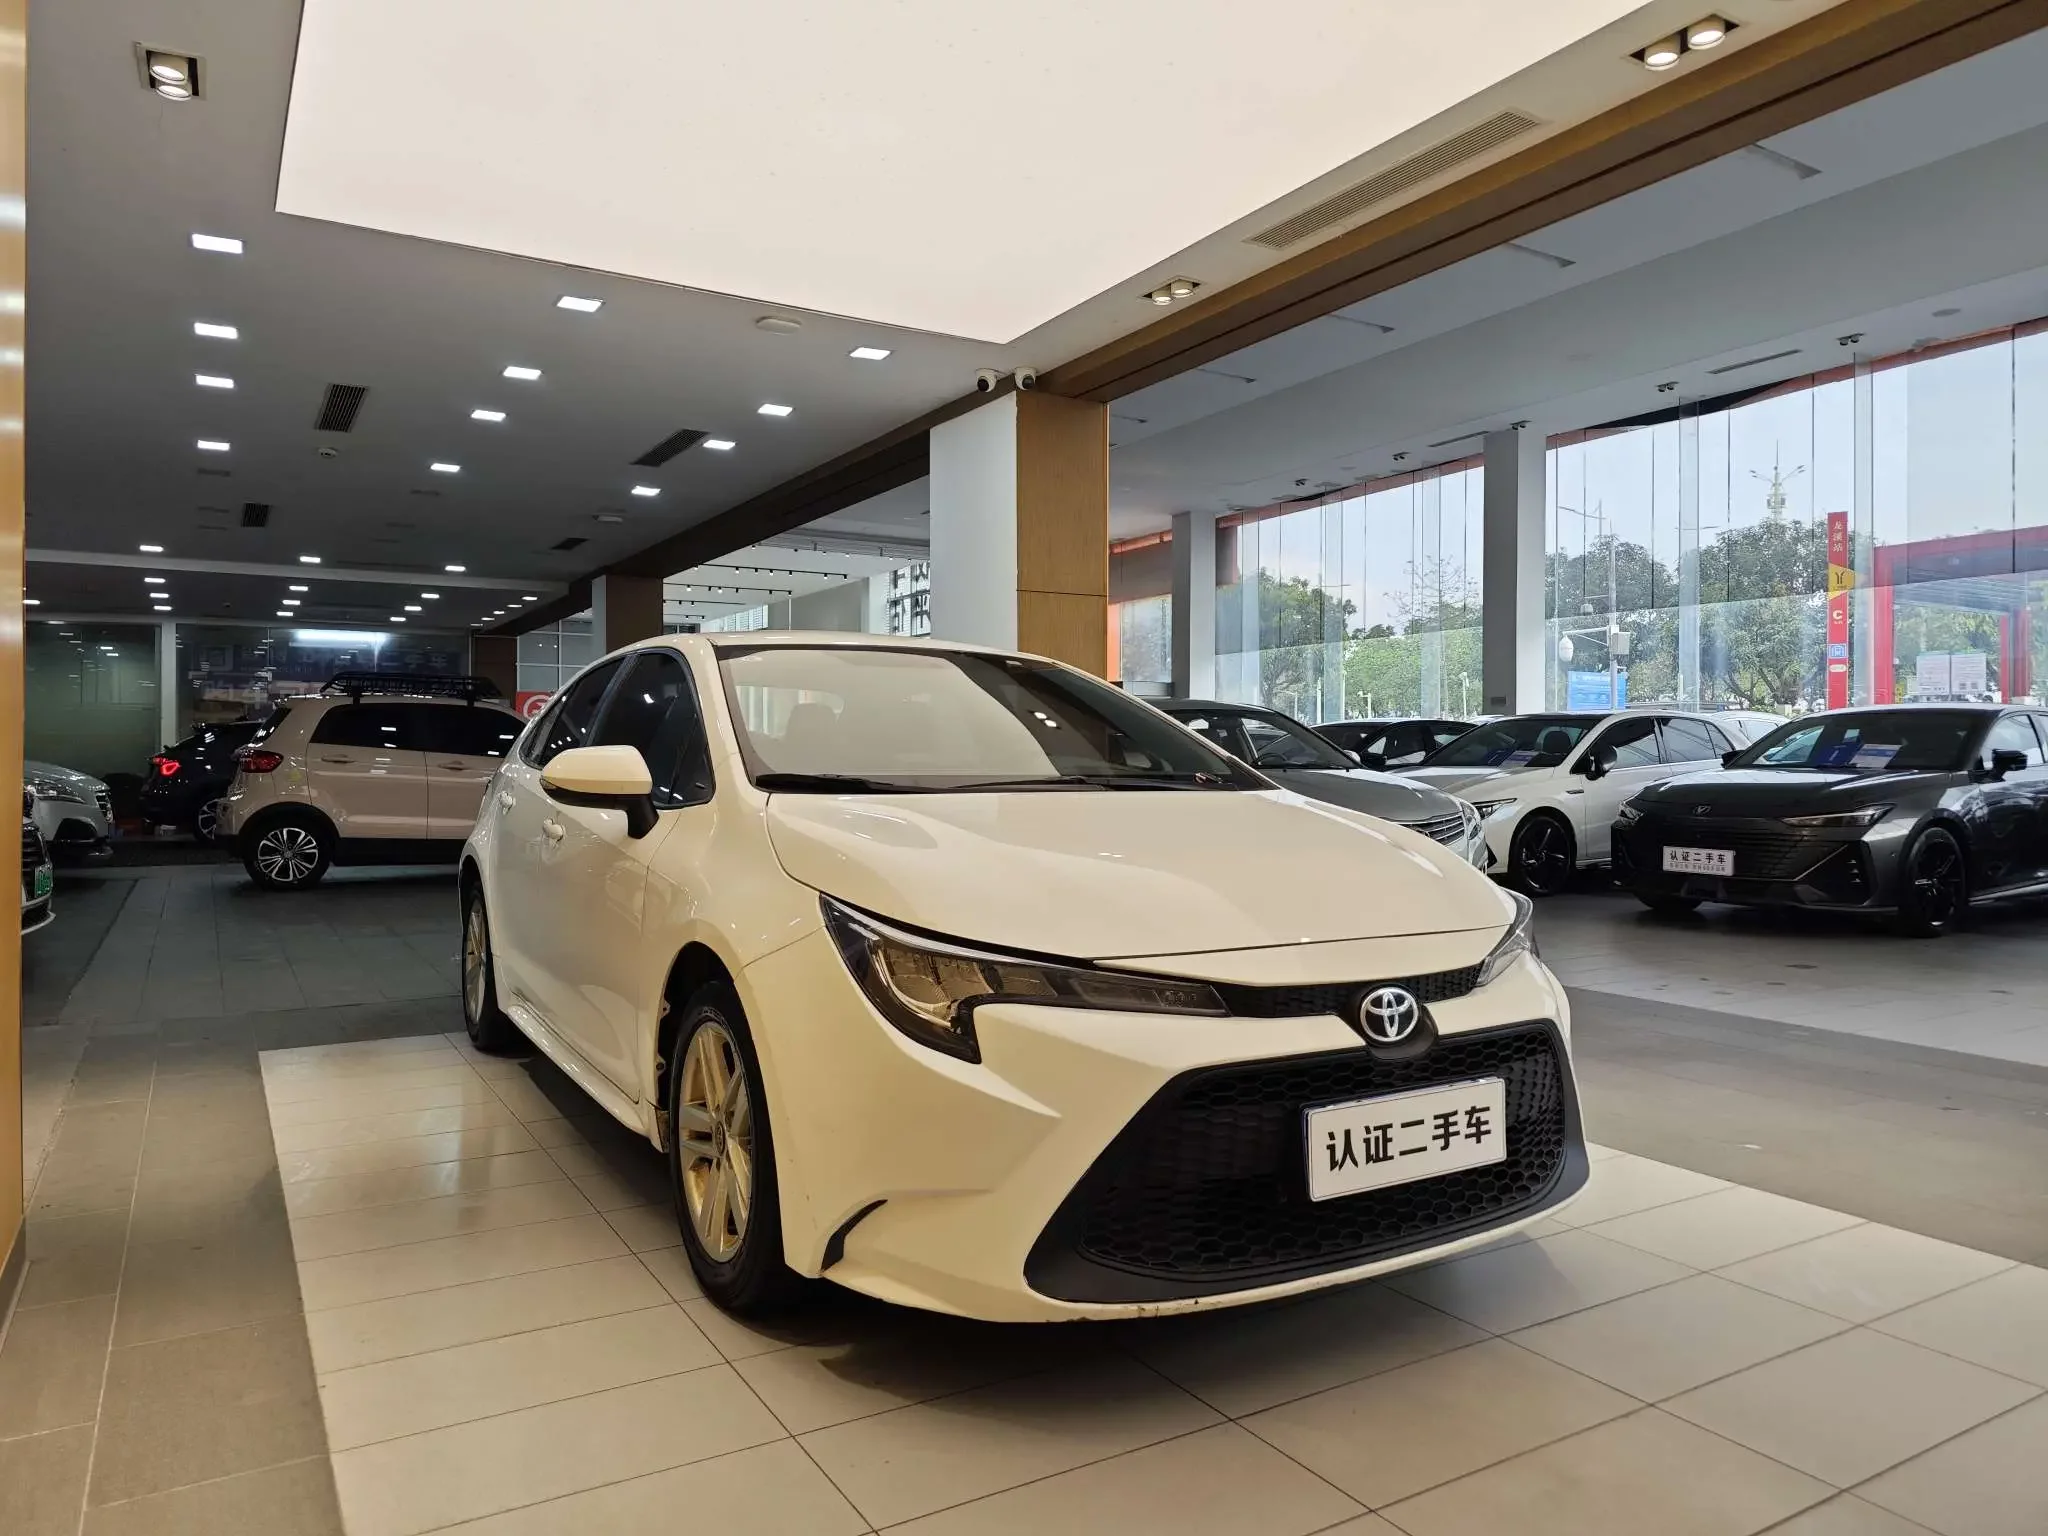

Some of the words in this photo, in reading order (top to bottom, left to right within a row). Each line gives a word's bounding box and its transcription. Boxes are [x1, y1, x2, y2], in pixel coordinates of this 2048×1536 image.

[1669, 849, 1726, 865] 认证二手车
[1326, 1106, 1491, 1171] 认证二手车
